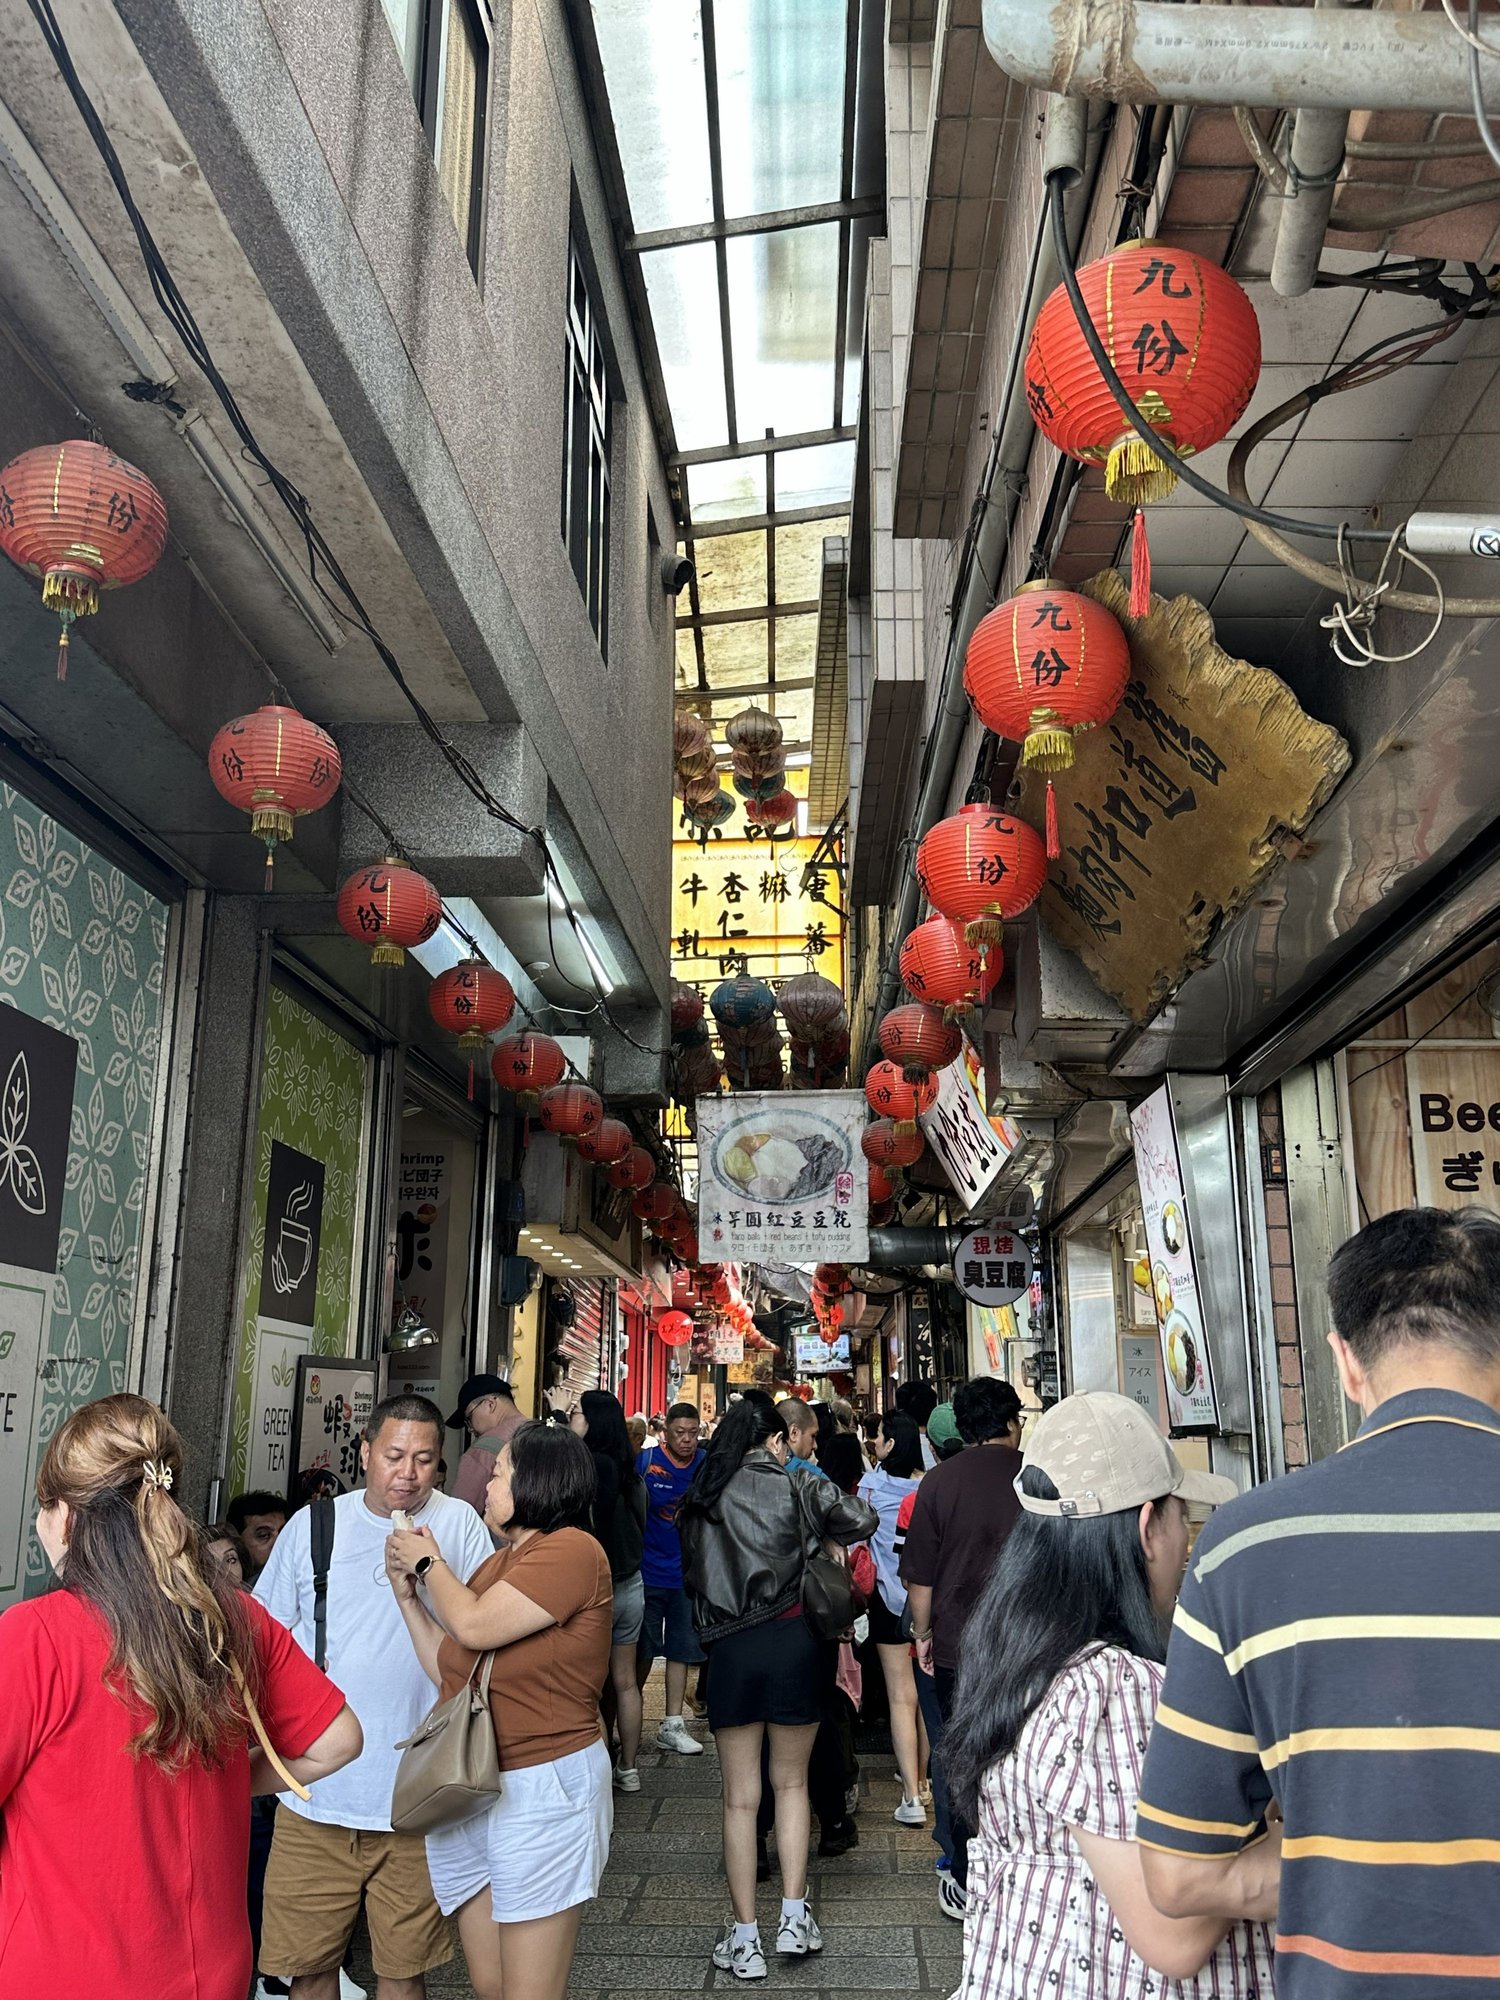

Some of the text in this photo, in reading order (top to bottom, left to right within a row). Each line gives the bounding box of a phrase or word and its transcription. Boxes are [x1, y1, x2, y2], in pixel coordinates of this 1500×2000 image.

[1132, 257, 1192, 376] 九份
[1030, 600, 1072, 687] 九份
[356, 868, 388, 933] 九份
[400, 1153, 445, 1167] hrimp
[1442, 1150, 1500, 1192] ぎ
[399, 1169, 443, 1183] ビ団子
[399, 1186, 439, 1200] 우완자
[973, 1235, 1014, 1255] 現烤
[963, 1260, 1027, 1289] 臭豆腐
[1129, 1367, 1152, 1378] アイス
[263, 1407, 293, 1436] GREEN
[267, 1443, 285, 1472] TEA
